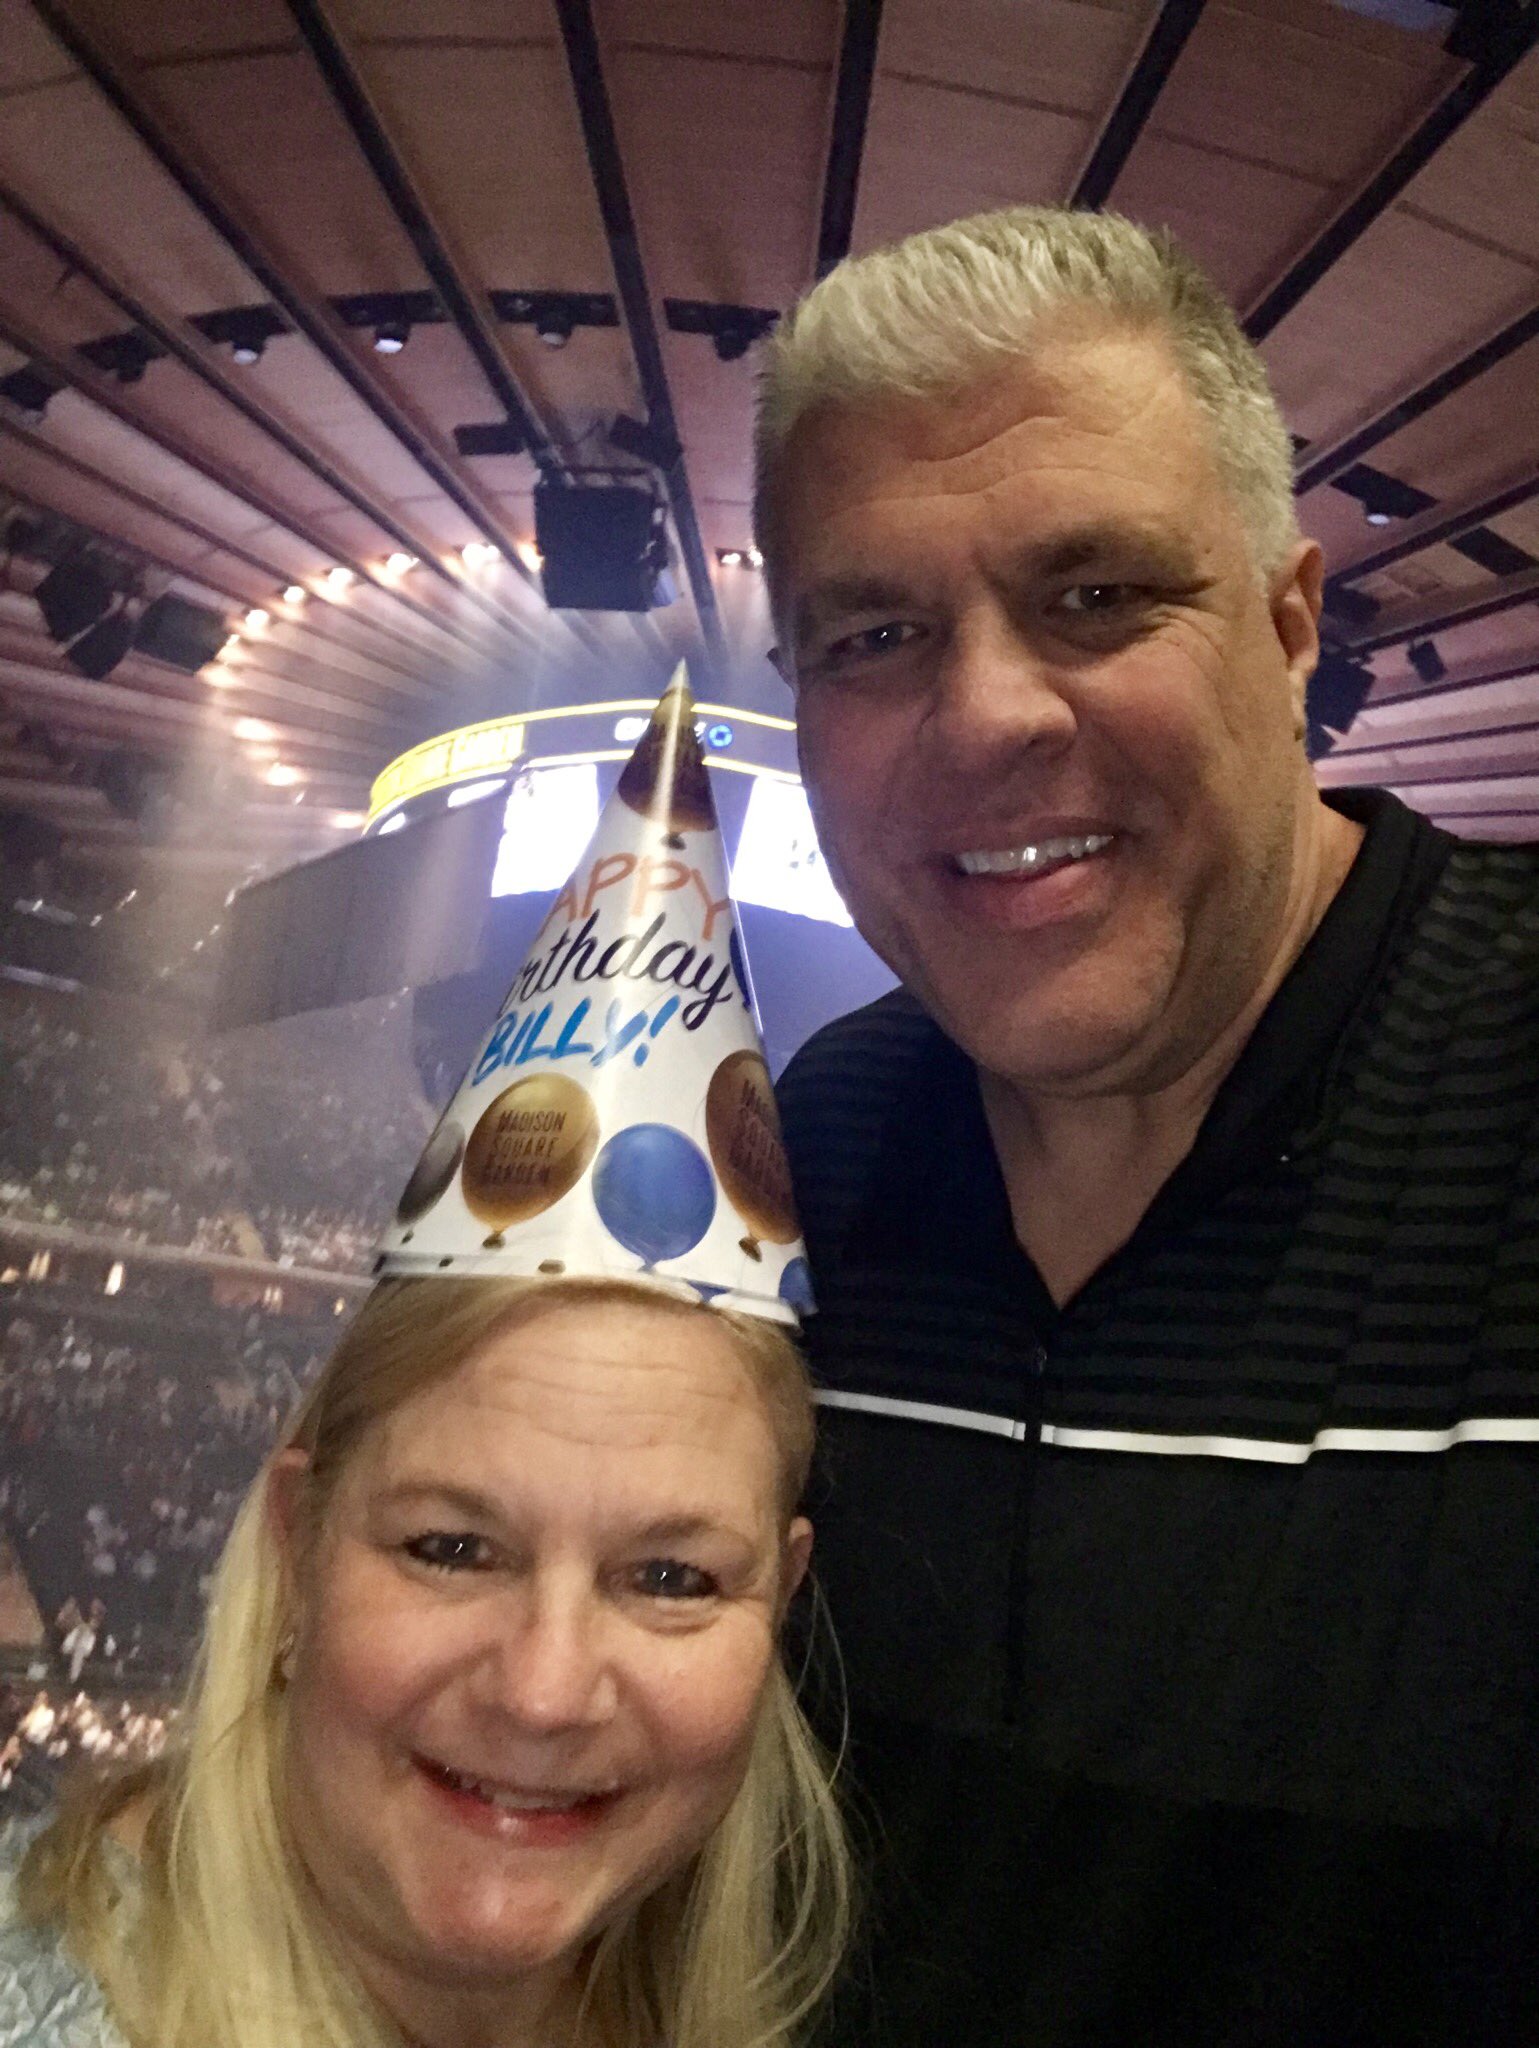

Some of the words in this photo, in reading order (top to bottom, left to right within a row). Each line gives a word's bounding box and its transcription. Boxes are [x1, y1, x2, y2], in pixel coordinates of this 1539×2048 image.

[537, 852, 730, 941] APPY
[471, 994, 681, 1087] BILLY!
[497, 1110, 567, 1132] MADISON
